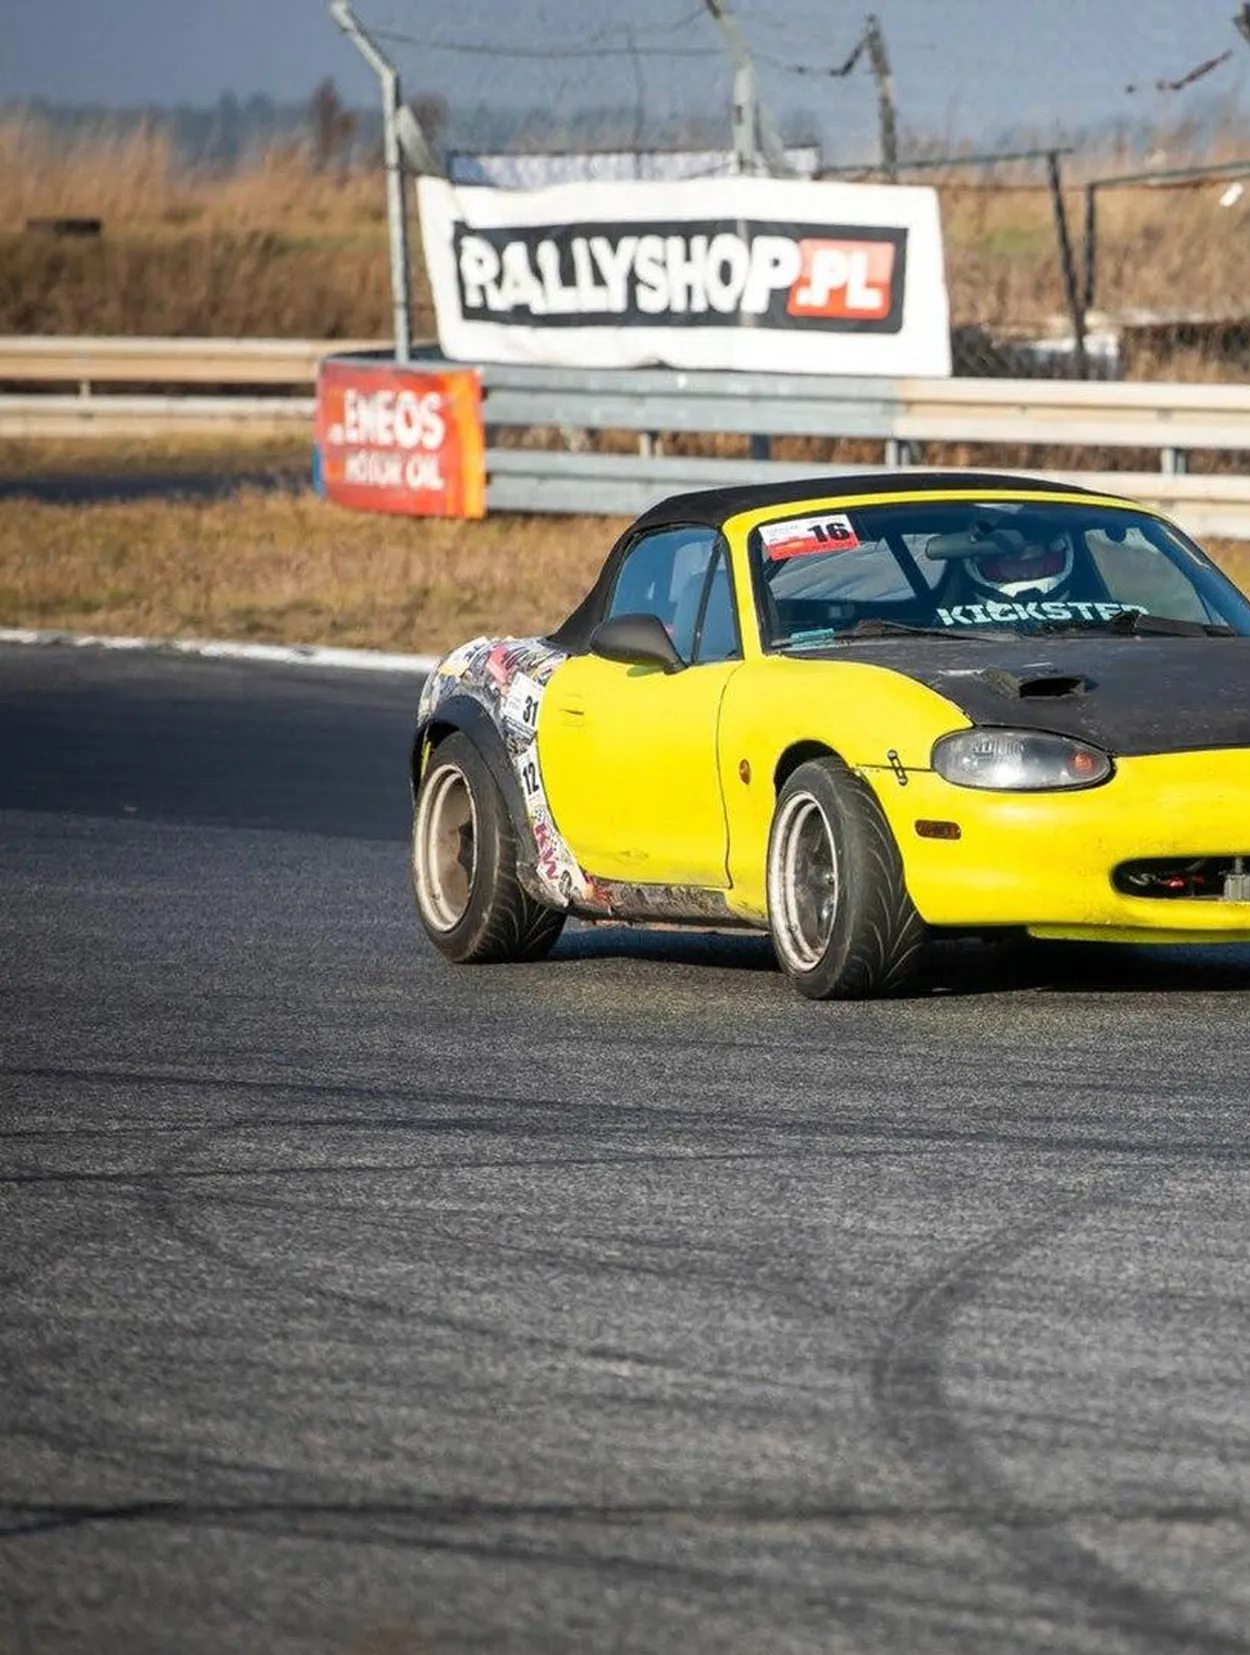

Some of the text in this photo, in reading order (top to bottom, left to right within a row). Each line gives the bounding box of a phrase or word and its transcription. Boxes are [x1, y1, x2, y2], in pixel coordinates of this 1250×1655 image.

[460, 233, 886, 314] RALLYSHOP.PL
[343, 388, 446, 450] ENEOS
[807, 522, 850, 543] 16
[523, 695, 539, 727] 31
[522, 762, 540, 795] 12
